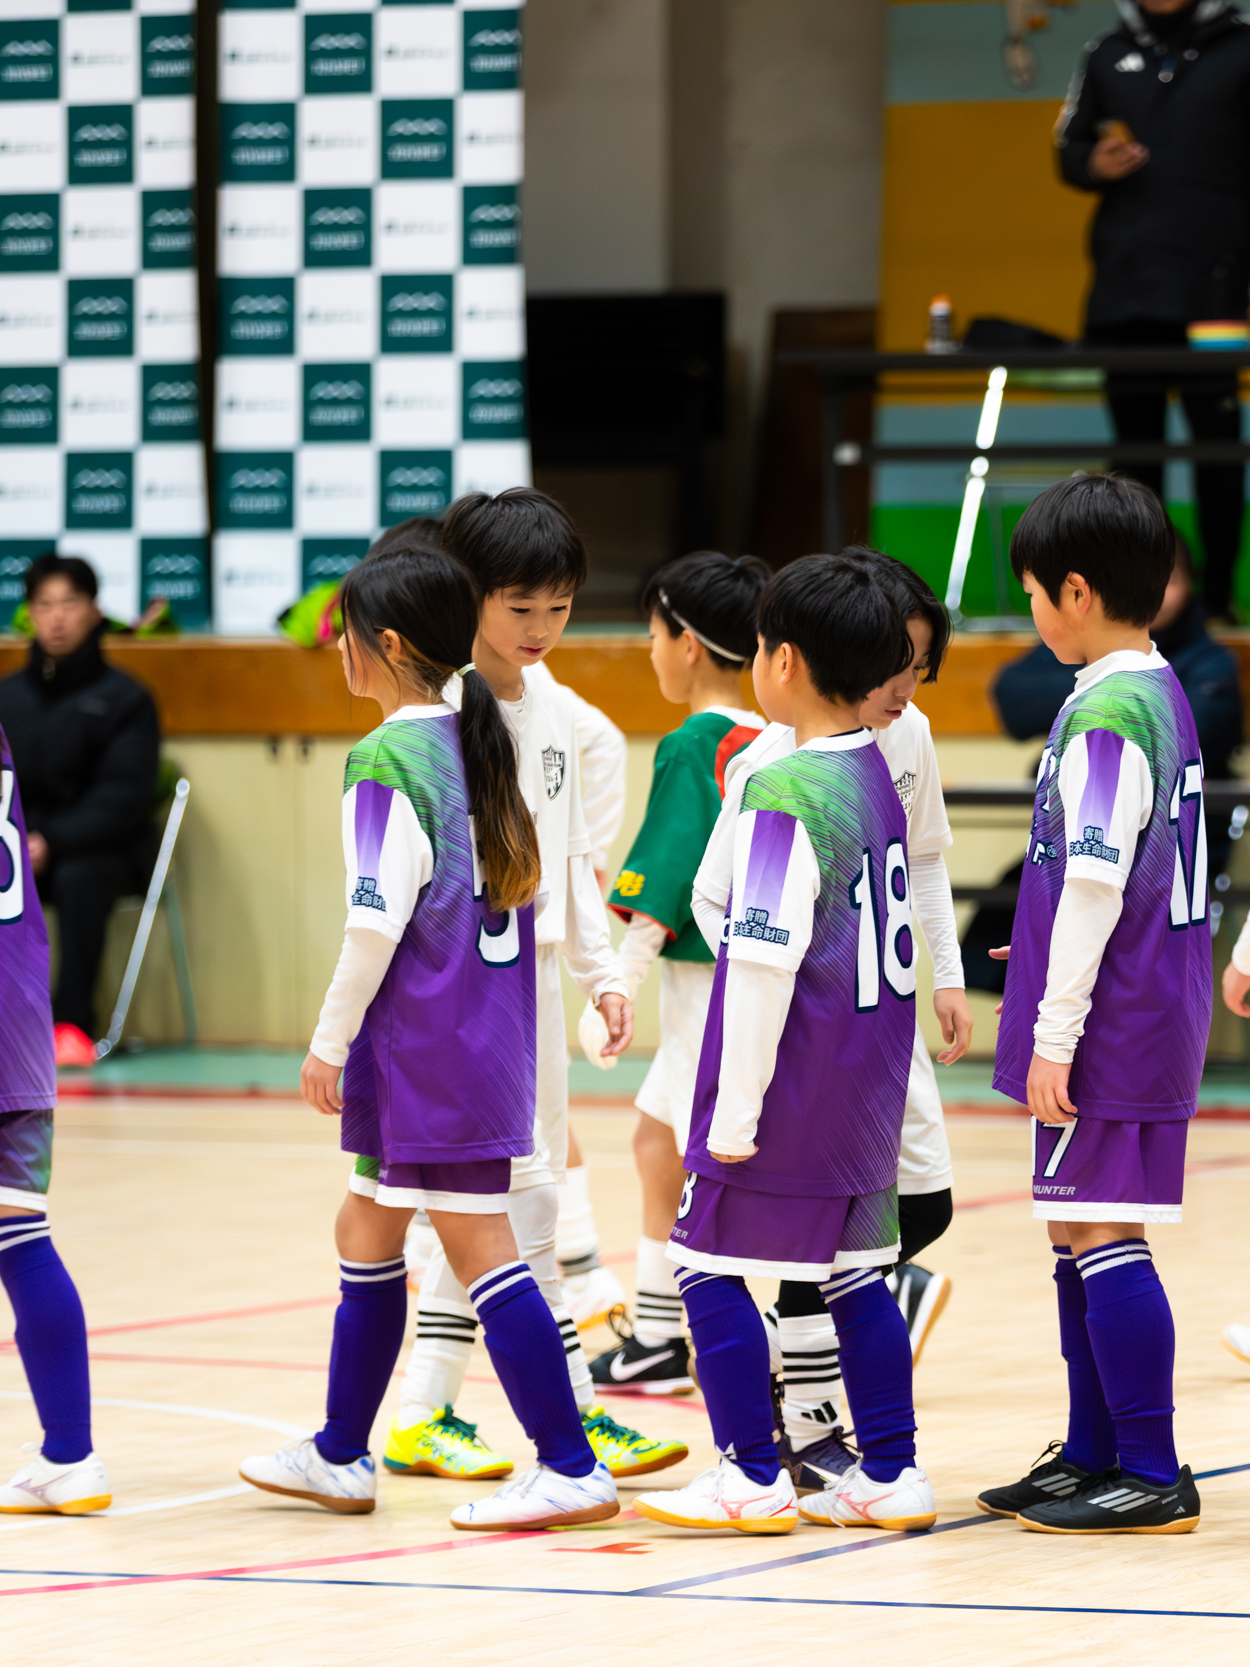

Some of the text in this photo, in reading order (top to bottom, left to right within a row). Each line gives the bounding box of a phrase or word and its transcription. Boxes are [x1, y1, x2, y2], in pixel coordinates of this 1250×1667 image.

[1083, 826, 1103, 843] 寄贈
[1169, 758, 1208, 931] 17
[1069, 841, 1120, 864] 日本生命財団
[746, 908, 769, 926] 寄贈
[849, 837, 916, 1014] 18
